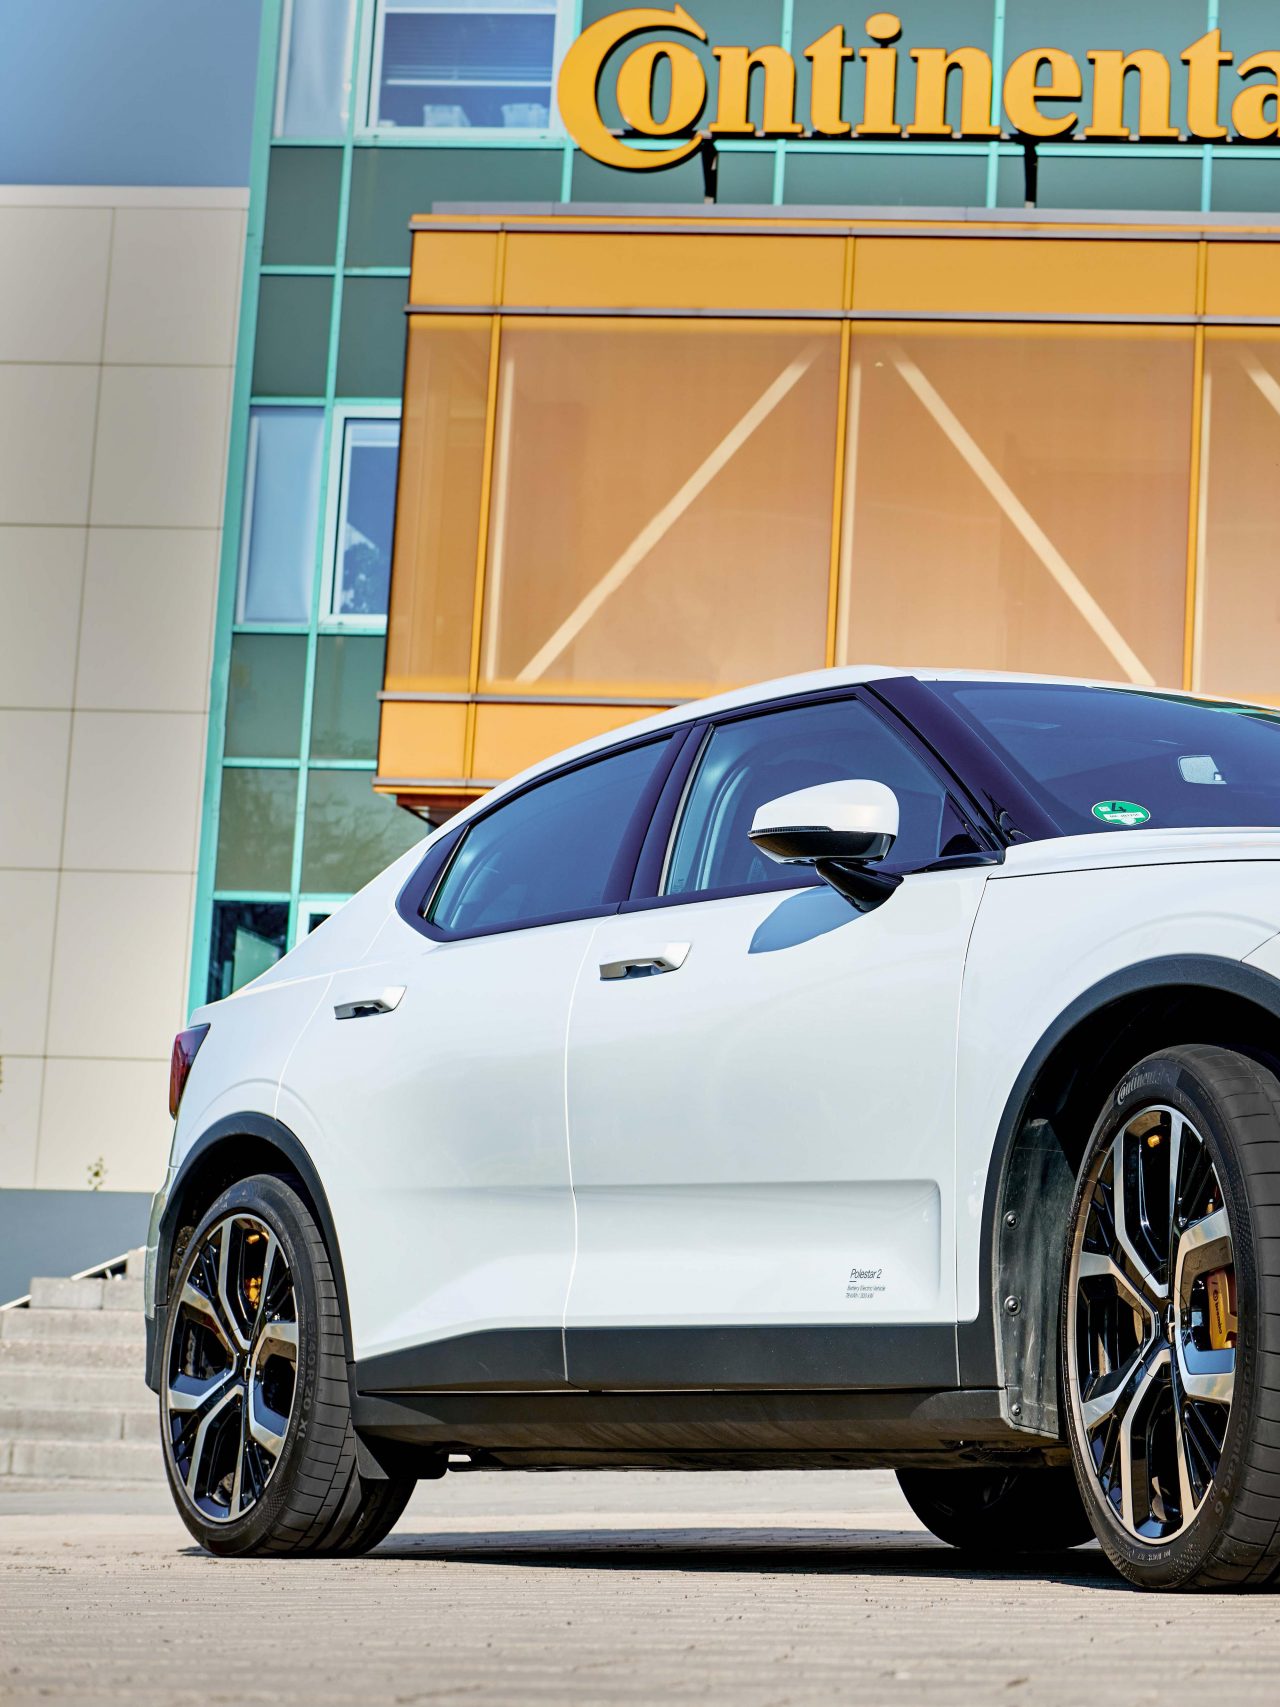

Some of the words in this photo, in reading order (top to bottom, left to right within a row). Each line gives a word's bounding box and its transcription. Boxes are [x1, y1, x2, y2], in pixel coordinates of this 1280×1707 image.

[1117, 1068, 1176, 1105] Continen
[850, 1268, 877, 1279] Polestar
[876, 1268, 883, 1279] 2
[296, 1418, 308, 1440] XL
[1215, 1500, 1225, 1517] 6
